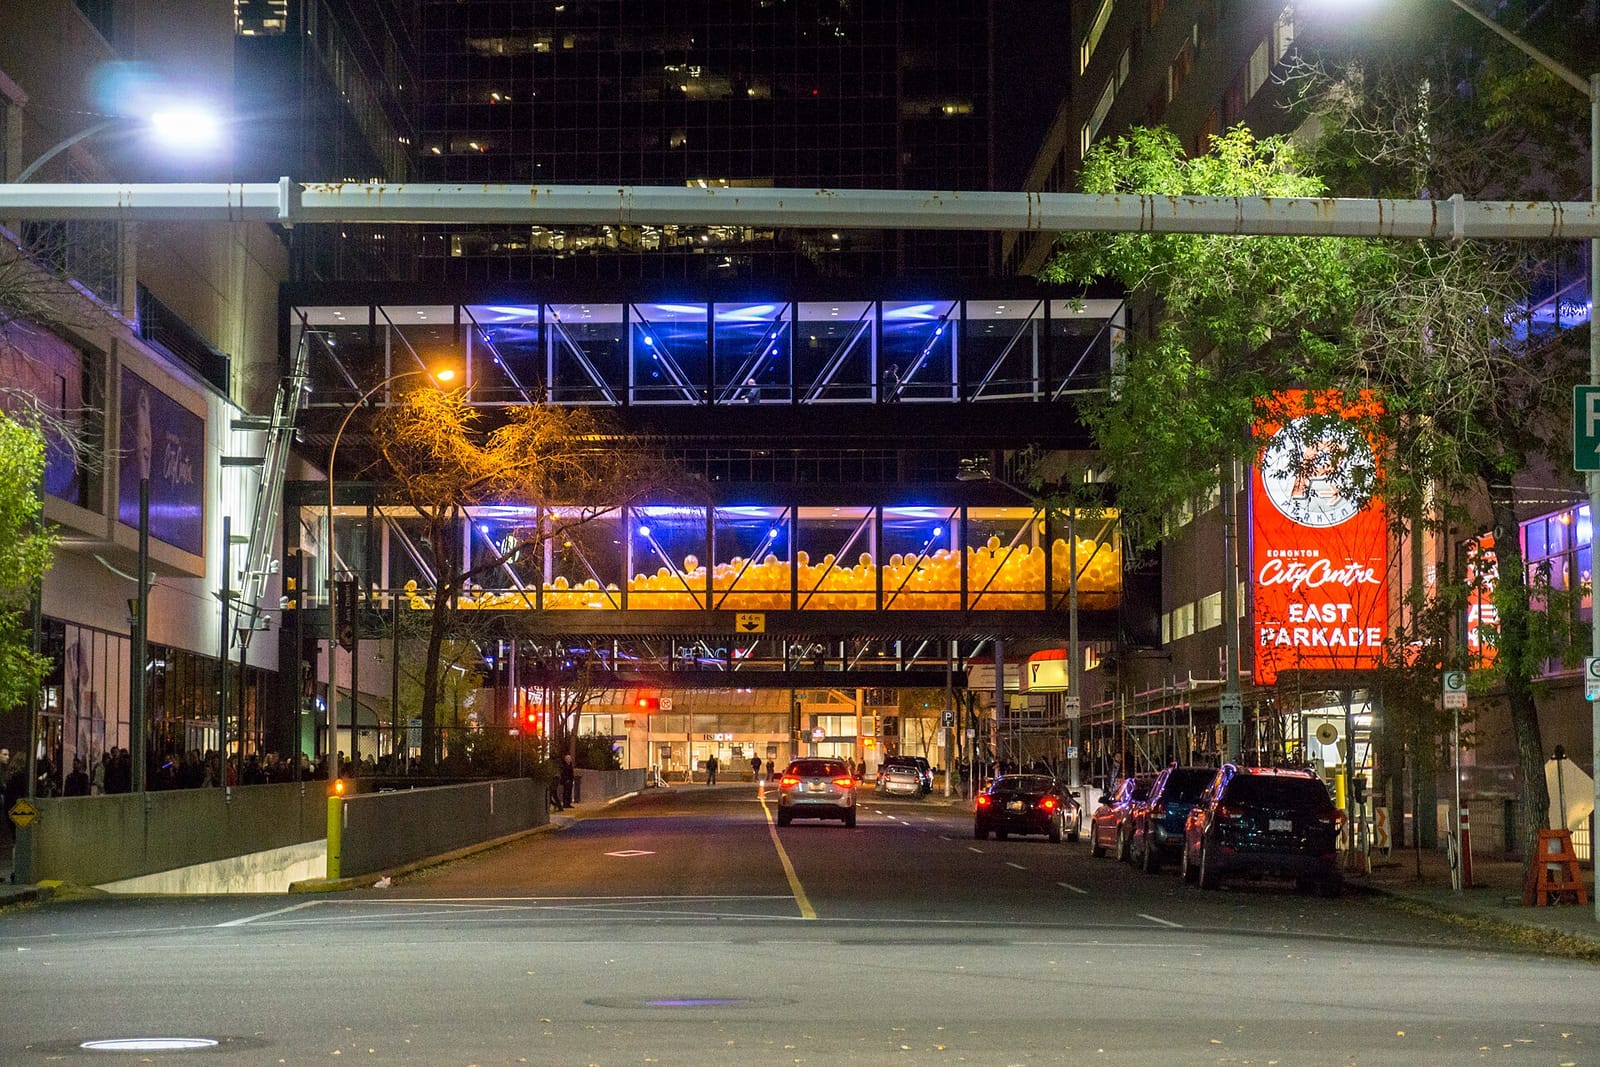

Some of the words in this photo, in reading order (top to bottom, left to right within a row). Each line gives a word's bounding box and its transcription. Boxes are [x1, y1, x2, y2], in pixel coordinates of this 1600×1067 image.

[1266, 549, 1320, 558] EDMONTON
[1288, 603, 1353, 623] EAST
[1260, 627, 1382, 647] PARKADE
[945, 712, 953, 721] P
